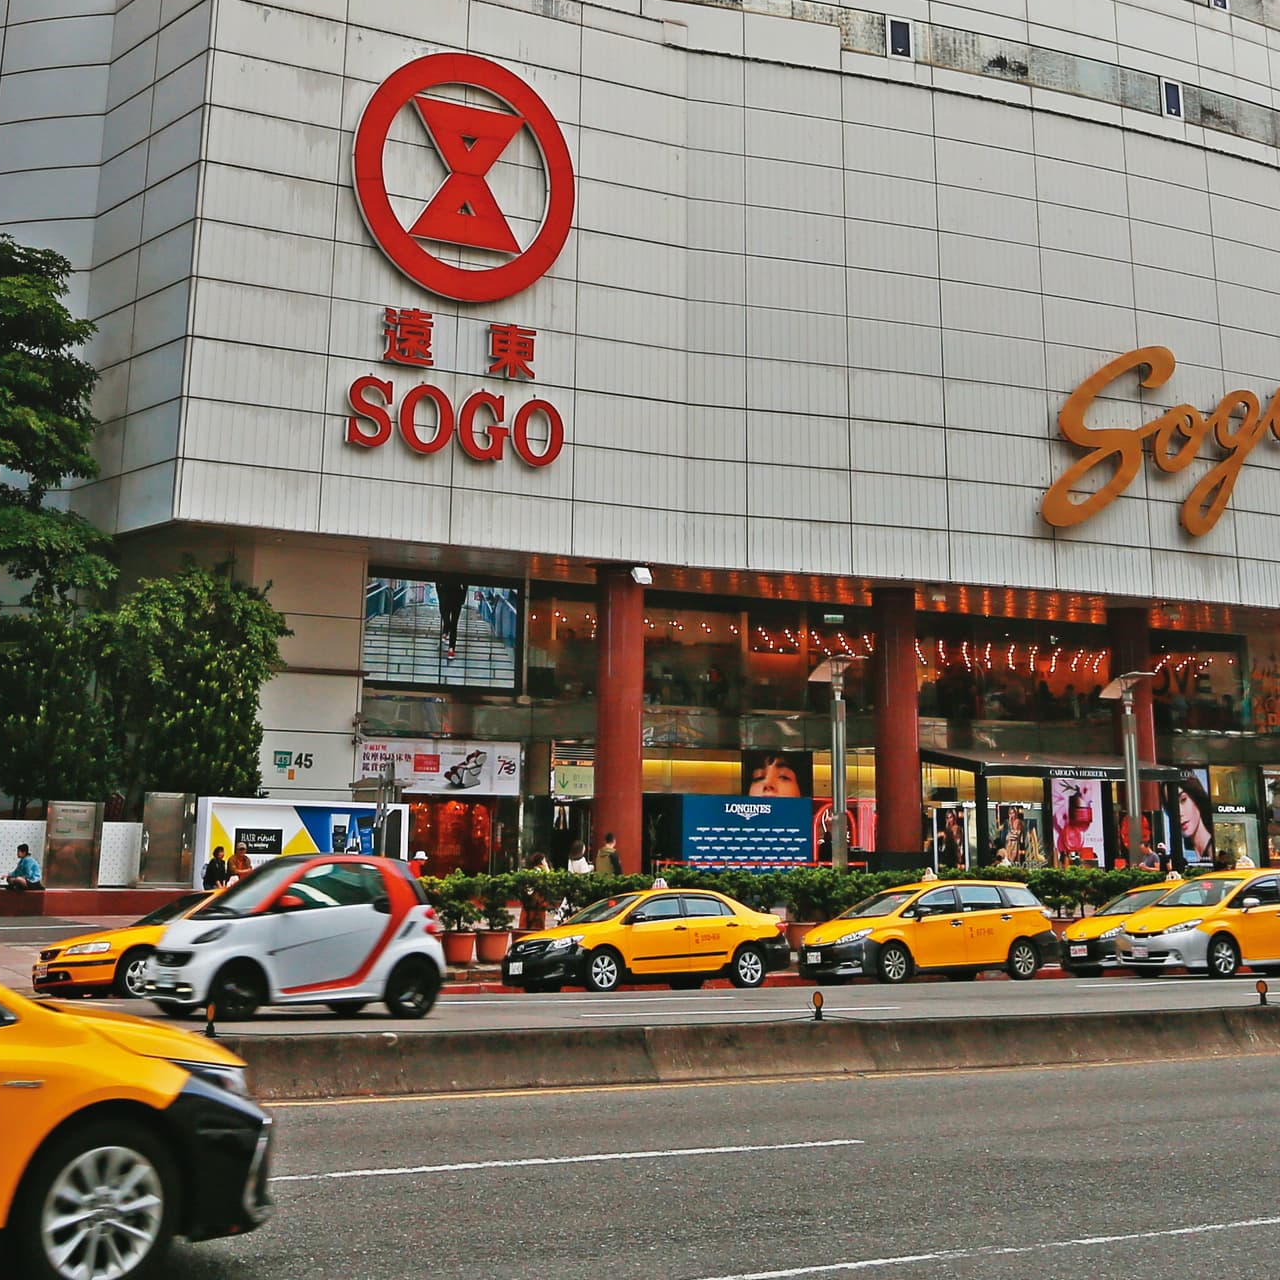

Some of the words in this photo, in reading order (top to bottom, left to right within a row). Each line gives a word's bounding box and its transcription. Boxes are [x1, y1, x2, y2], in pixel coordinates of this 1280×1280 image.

[381, 307, 538, 380] 遠東
[344, 373, 565, 468] SOGO
[294, 752, 313, 769] 45
[1049, 768, 1079, 777] CAROLINA
[725, 803, 772, 814] LONGINES
